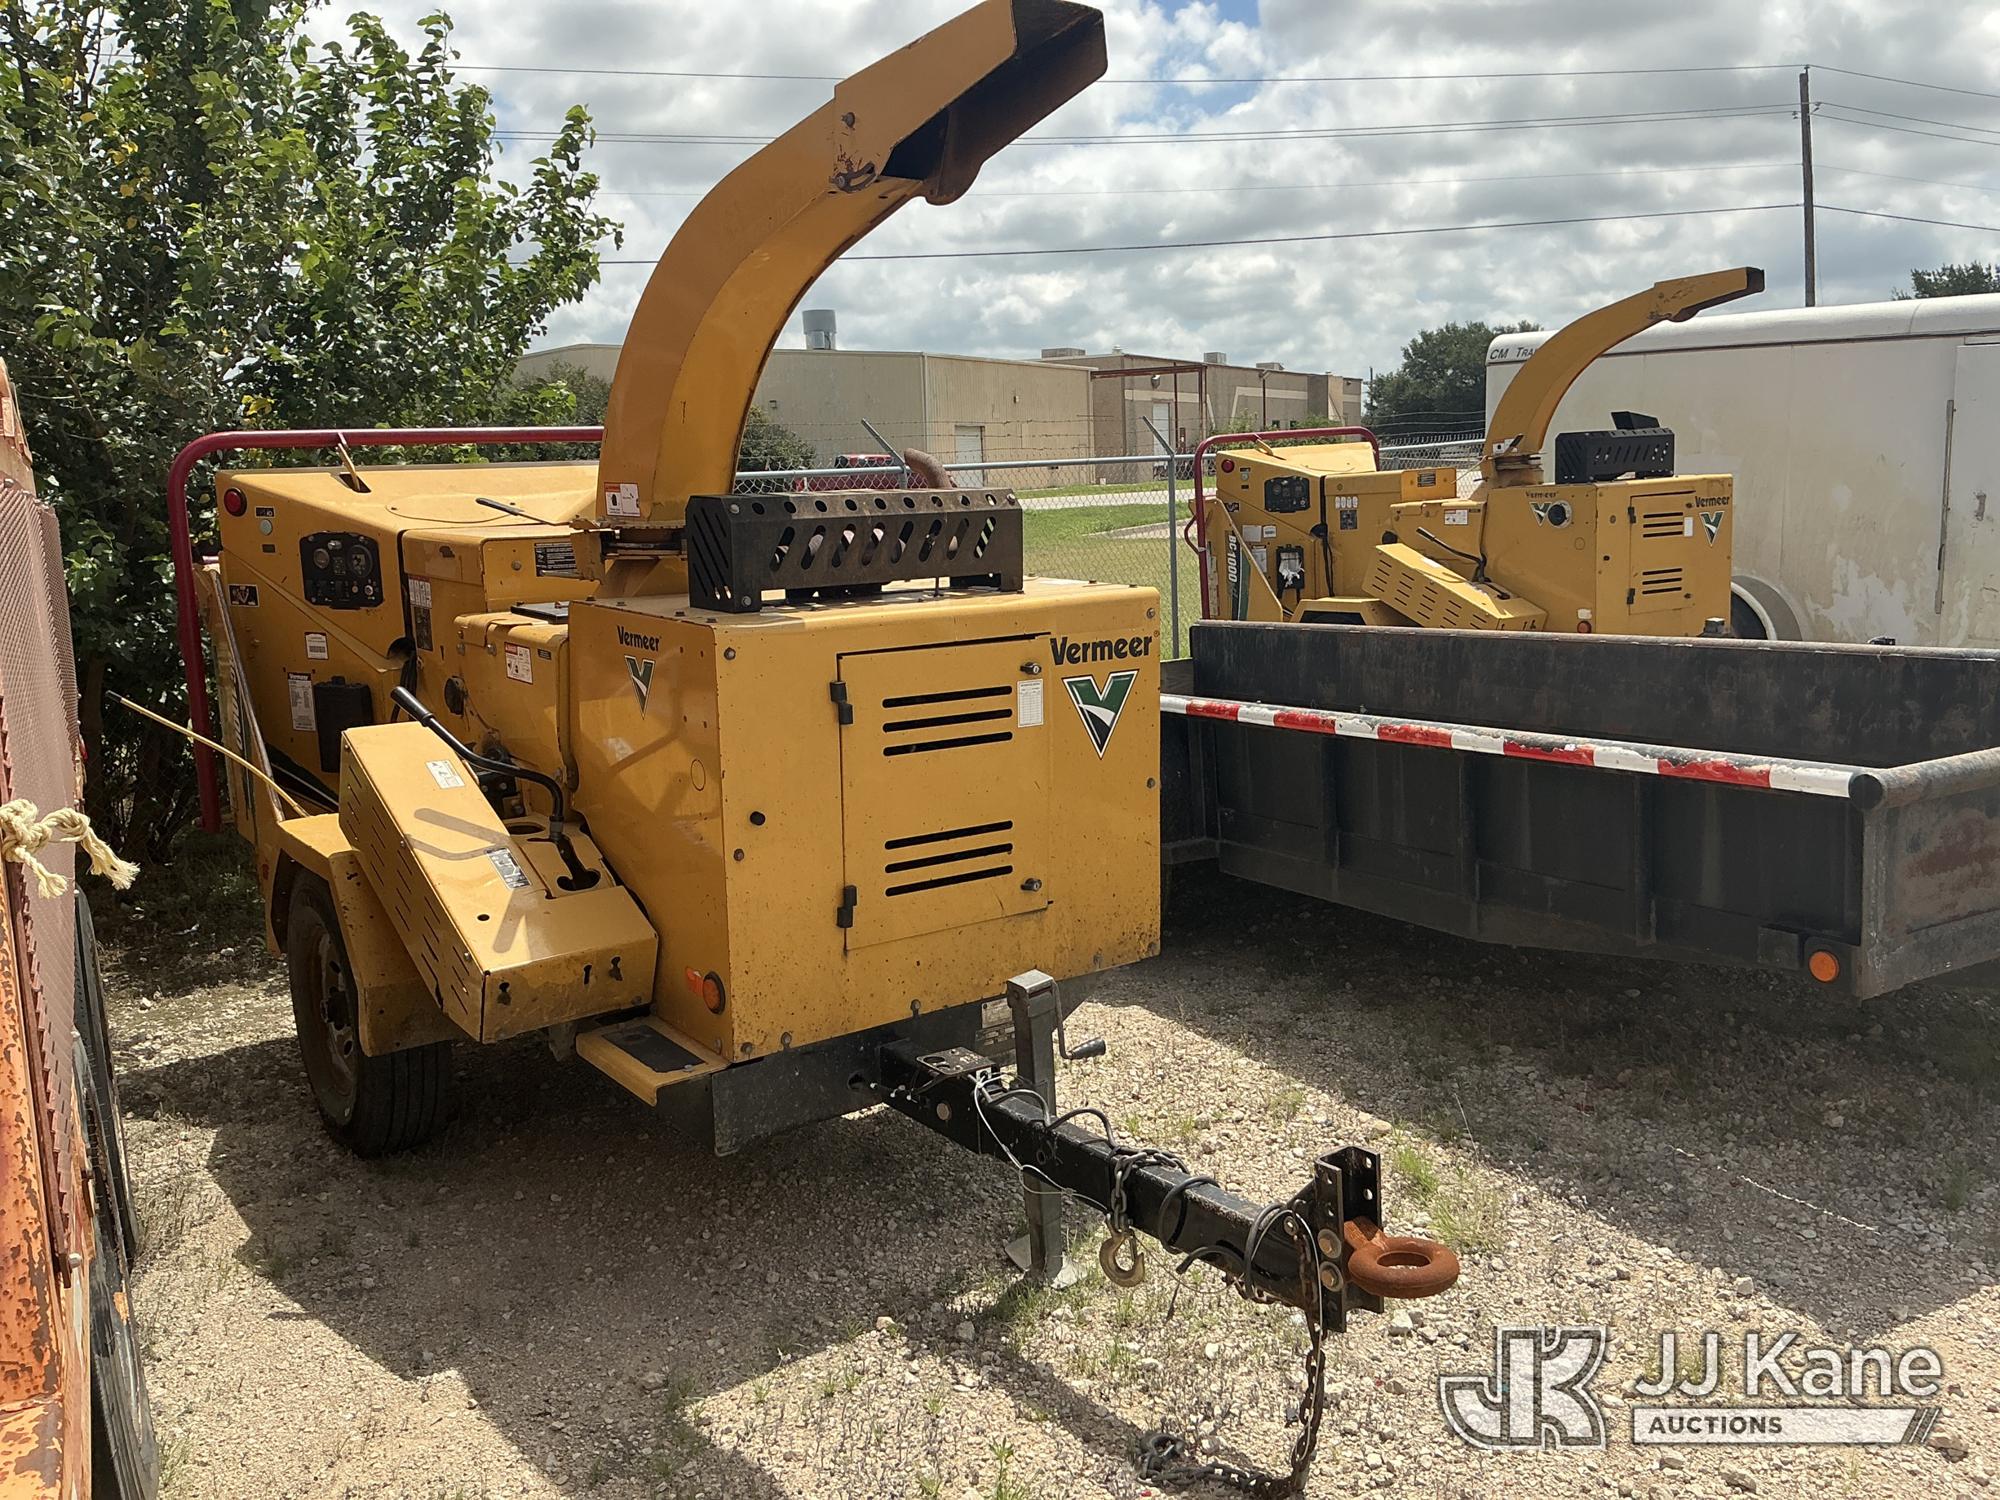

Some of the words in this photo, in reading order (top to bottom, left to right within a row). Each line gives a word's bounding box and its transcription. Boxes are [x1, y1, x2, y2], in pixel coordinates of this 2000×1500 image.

[1490, 348, 1509, 360] CM
[1695, 495, 1730, 508] Vermeer
[1227, 535, 1238, 583] BC1000
[616, 625, 661, 652] Vermeer
[1049, 635, 1153, 666] Vermeer
